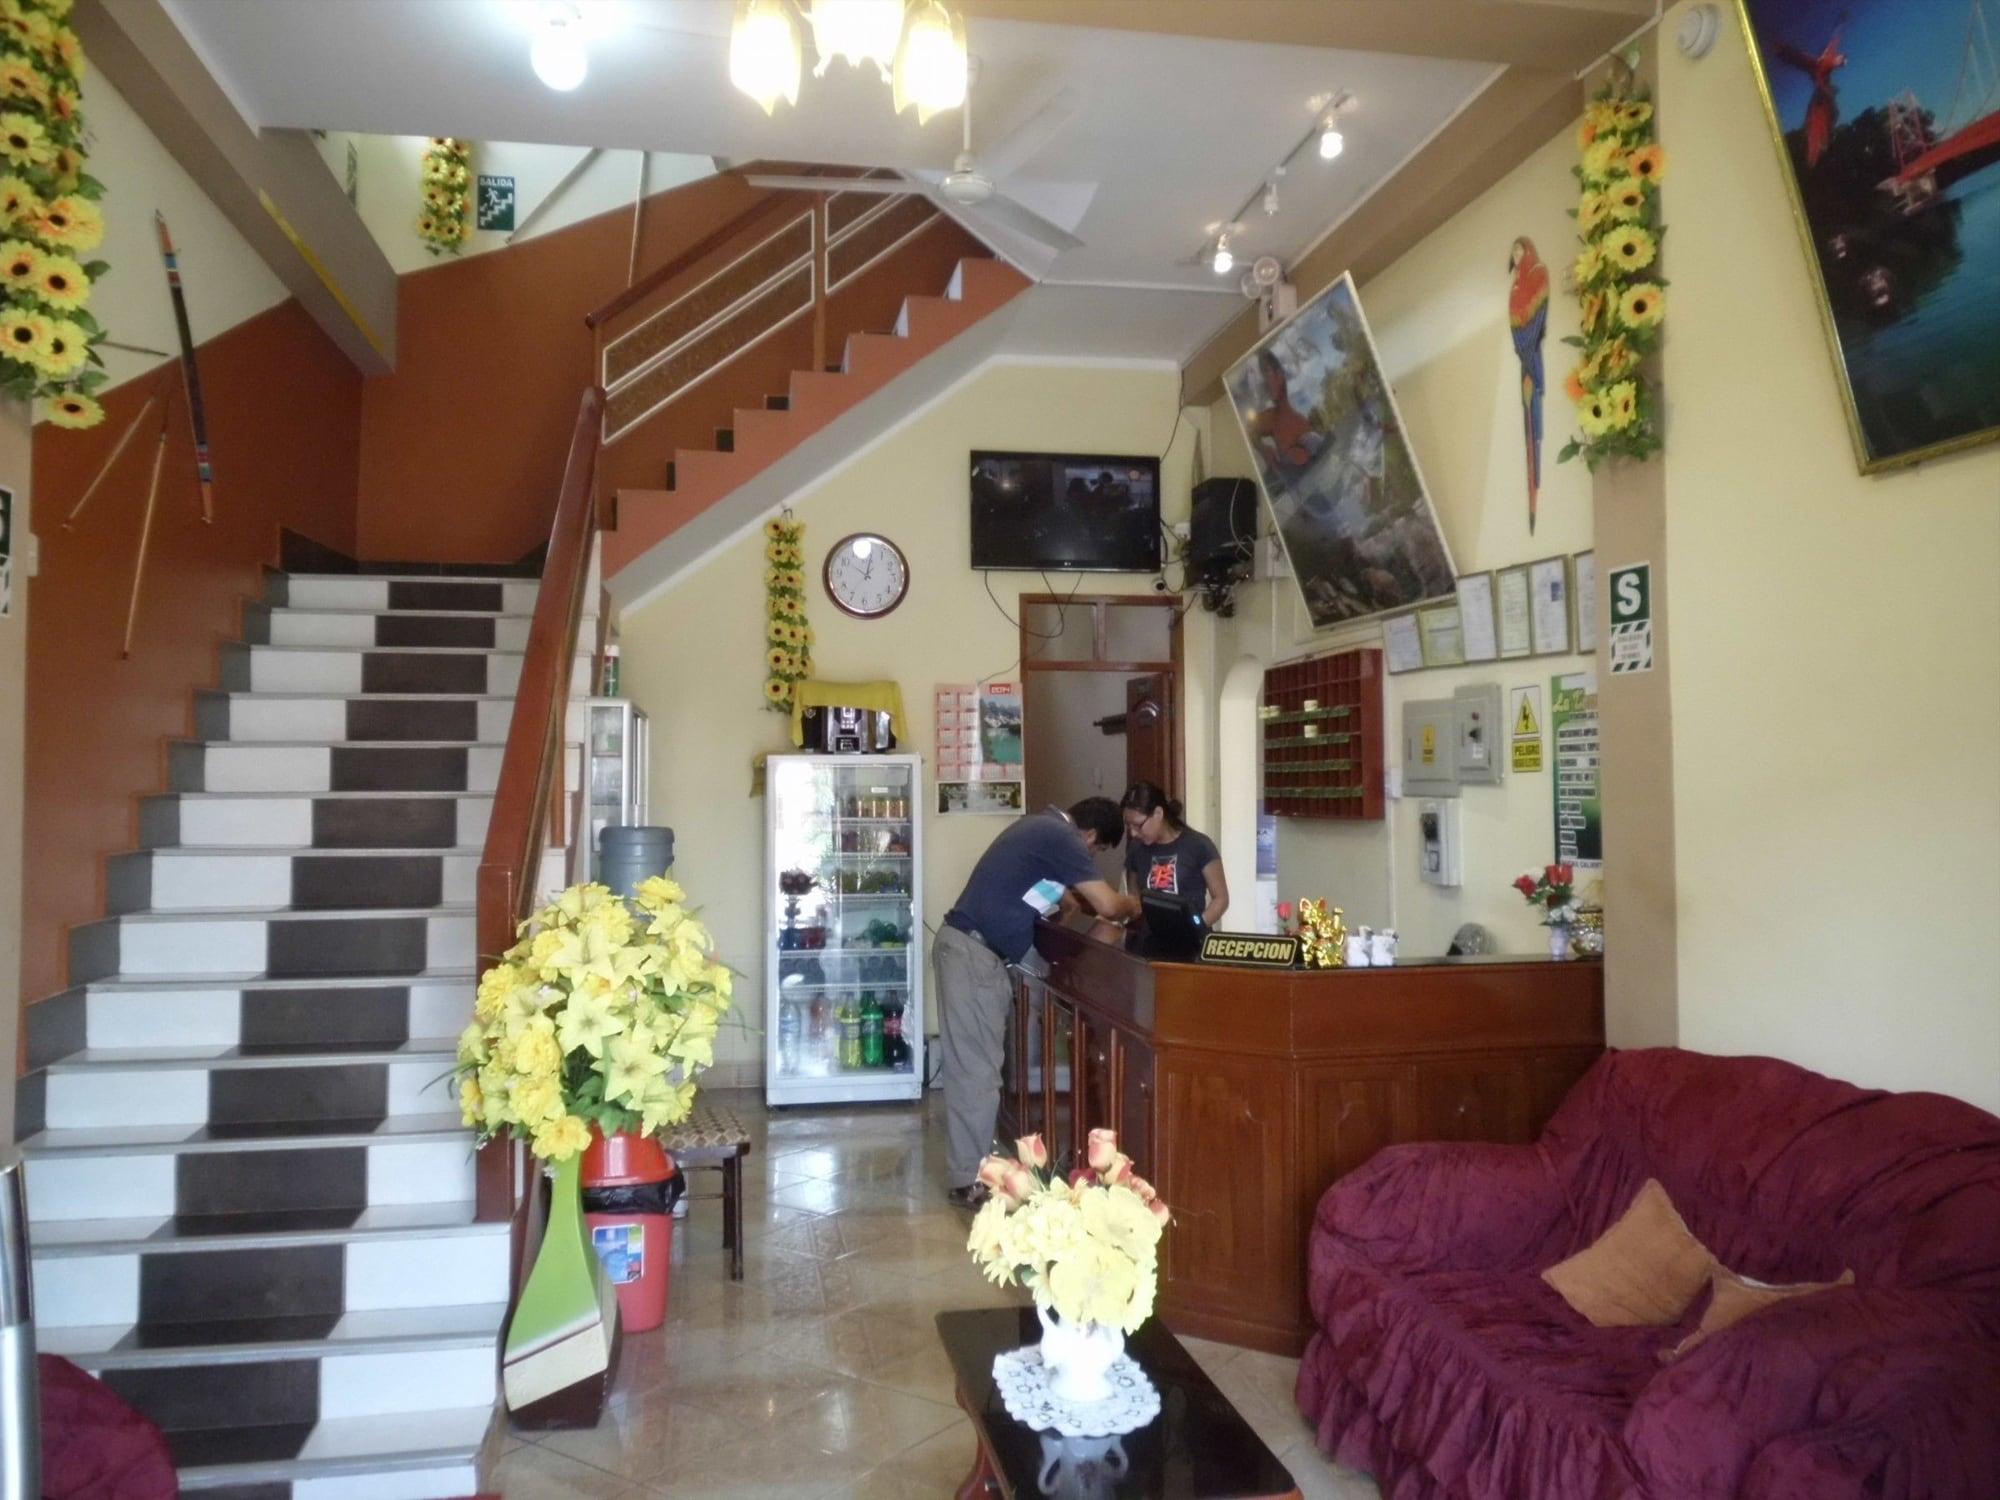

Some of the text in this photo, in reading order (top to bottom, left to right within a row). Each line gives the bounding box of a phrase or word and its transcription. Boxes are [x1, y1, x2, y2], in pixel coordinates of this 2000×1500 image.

[480, 177, 513, 187] SALIDA
[1617, 572, 1642, 615] S
[1514, 743, 1540, 756] PELIGRO
[1206, 939, 1292, 960] RECEPCION
